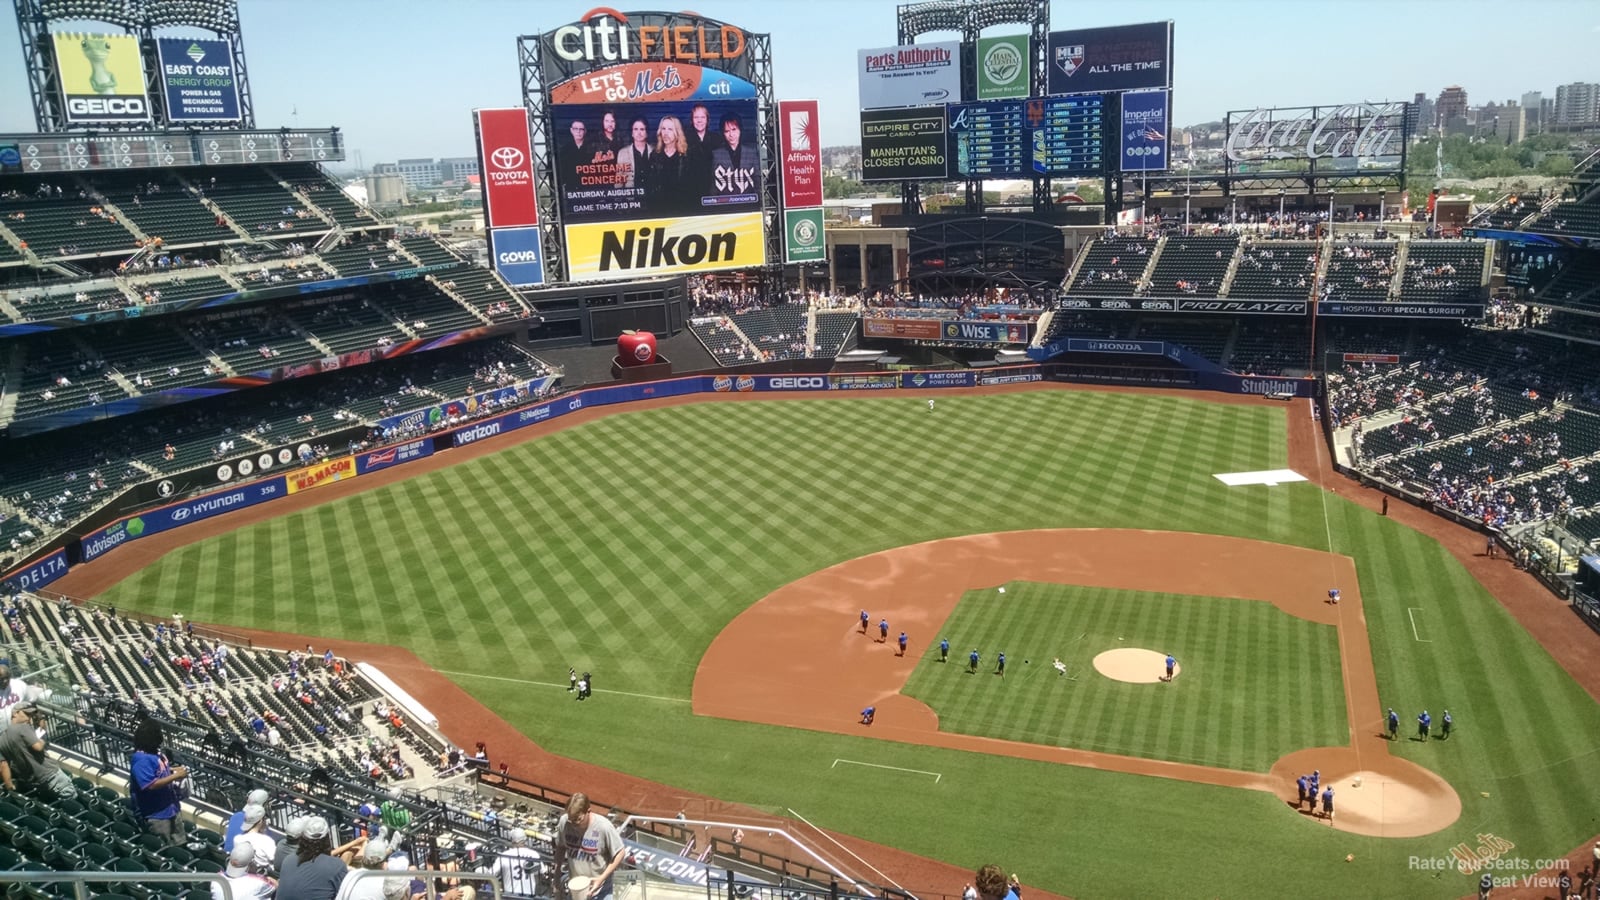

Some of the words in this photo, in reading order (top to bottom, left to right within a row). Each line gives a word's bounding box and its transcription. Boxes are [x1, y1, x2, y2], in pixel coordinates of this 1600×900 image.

[639, 25, 745, 60] FIELD
[866, 52, 895, 67] Parts
[897, 46, 951, 64] Authority
[1057, 47, 1082, 57] MLB
[165, 64, 194, 74] EAST
[196, 66, 230, 76] COAST
[1088, 65, 1109, 74] ALL
[1111, 63, 1132, 72] THE
[1134, 60, 1160, 70] TIME
[168, 78, 201, 86] ENERGY
[204, 78, 232, 87] GROUP
[580, 72, 624, 94] LET'S
[628, 66, 682, 99] Mets
[708, 80, 731, 95] citi
[605, 86, 628, 101] GO
[69, 99, 144, 114] GEICO
[1124, 108, 1162, 120] Imperial
[866, 124, 910, 133] EMPIRE
[787, 153, 816, 163] Affinity
[870, 146, 936, 158] MANHATTAN'S
[864, 158, 906, 168] CLOSEST
[908, 156, 944, 166] CASINO
[576, 164, 632, 174] POSTGAME
[790, 165, 815, 176] Health
[489, 171, 529, 180] TOYOTA
[580, 175, 628, 186] CONCERT
[794, 176, 811, 185] Plan
[568, 190, 606, 199] SATURDAY,
[608, 189, 634, 197] AUGUST
[636, 188, 644, 196] 13
[573, 204, 598, 212] GAME
[599, 203, 612, 211] TIME
[614, 202, 628, 210] 7:10
[600, 227, 737, 272] Nikon
[500, 250, 536, 263] GOYA
[1180, 302, 1222, 310] PRO
[1223, 303, 1304, 312] PLAYER
[1342, 305, 1376, 313] HOSPITAL
[1394, 306, 1427, 314] SPECIAL
[1429, 307, 1466, 315] SURGERY
[1099, 343, 1142, 351] HONDA
[714, 379, 731, 388] Gulf
[737, 379, 754, 388] Gulf
[770, 377, 823, 388] GEICO
[1241, 378, 1298, 394] StubHub!
[569, 398, 582, 410] citi
[527, 406, 550, 420] National
[457, 422, 500, 444] verizon
[262, 458, 270, 466] 41
[281, 452, 289, 460] 42
[220, 469, 229, 477] 37
[315, 461, 351, 480] MASON
[260, 486, 276, 496] 358
[193, 493, 245, 515] HYUNDAI
[85, 530, 126, 559] Advisors
[20, 556, 66, 589] DELTA
[1449, 832, 1516, 875] Mets
